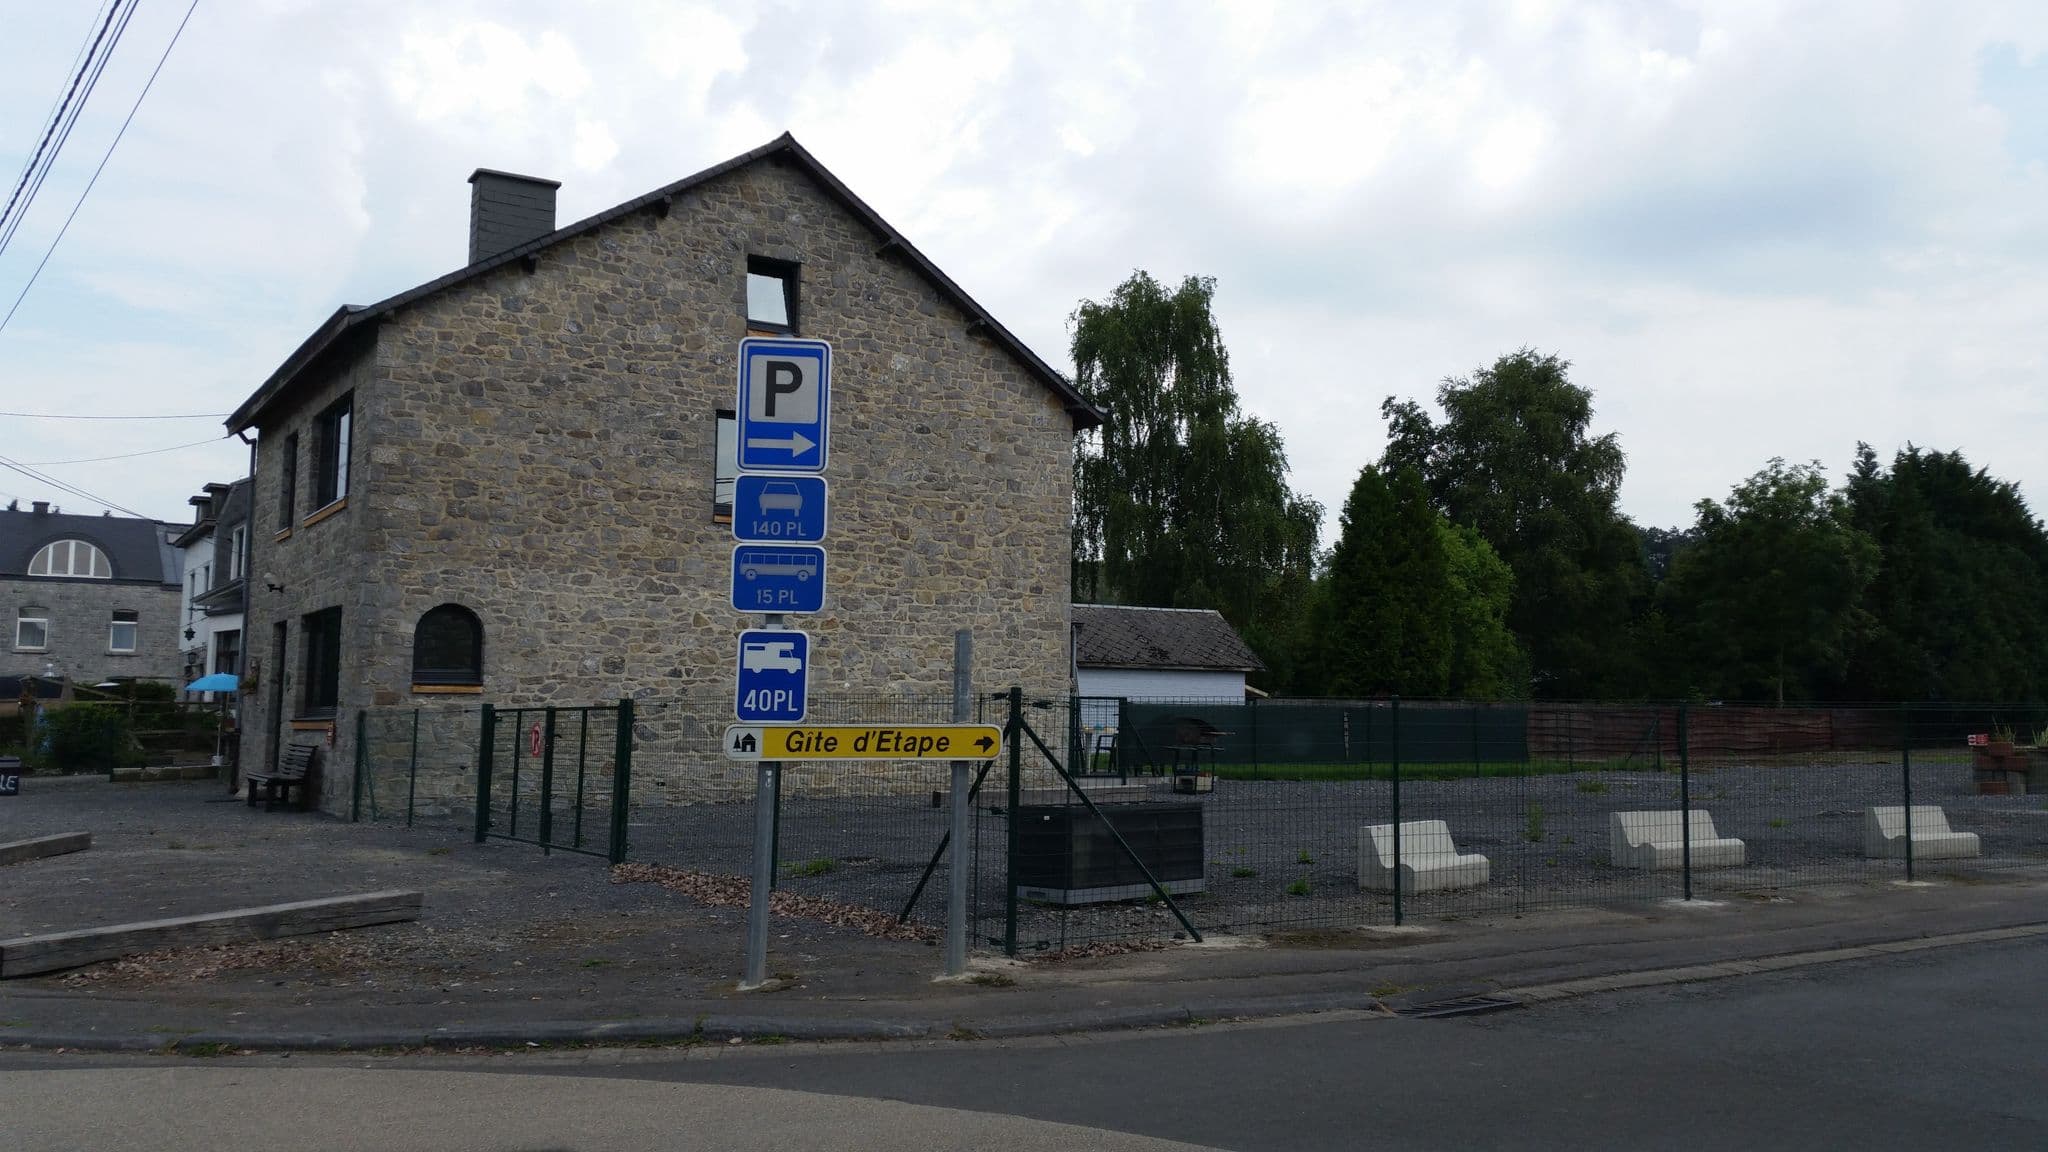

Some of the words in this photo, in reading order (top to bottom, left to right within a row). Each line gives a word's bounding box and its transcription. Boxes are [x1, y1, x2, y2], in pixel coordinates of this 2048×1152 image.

[765, 361, 803, 417] P
[753, 521, 781, 537] 140
[786, 522, 807, 537] PL
[757, 589, 774, 604] 15
[778, 590, 799, 605] PL
[743, 690, 799, 713] 40PL
[785, 730, 838, 753] Gîte
[853, 730, 949, 757] d'Etape
[0, 774, 18, 791] LE
